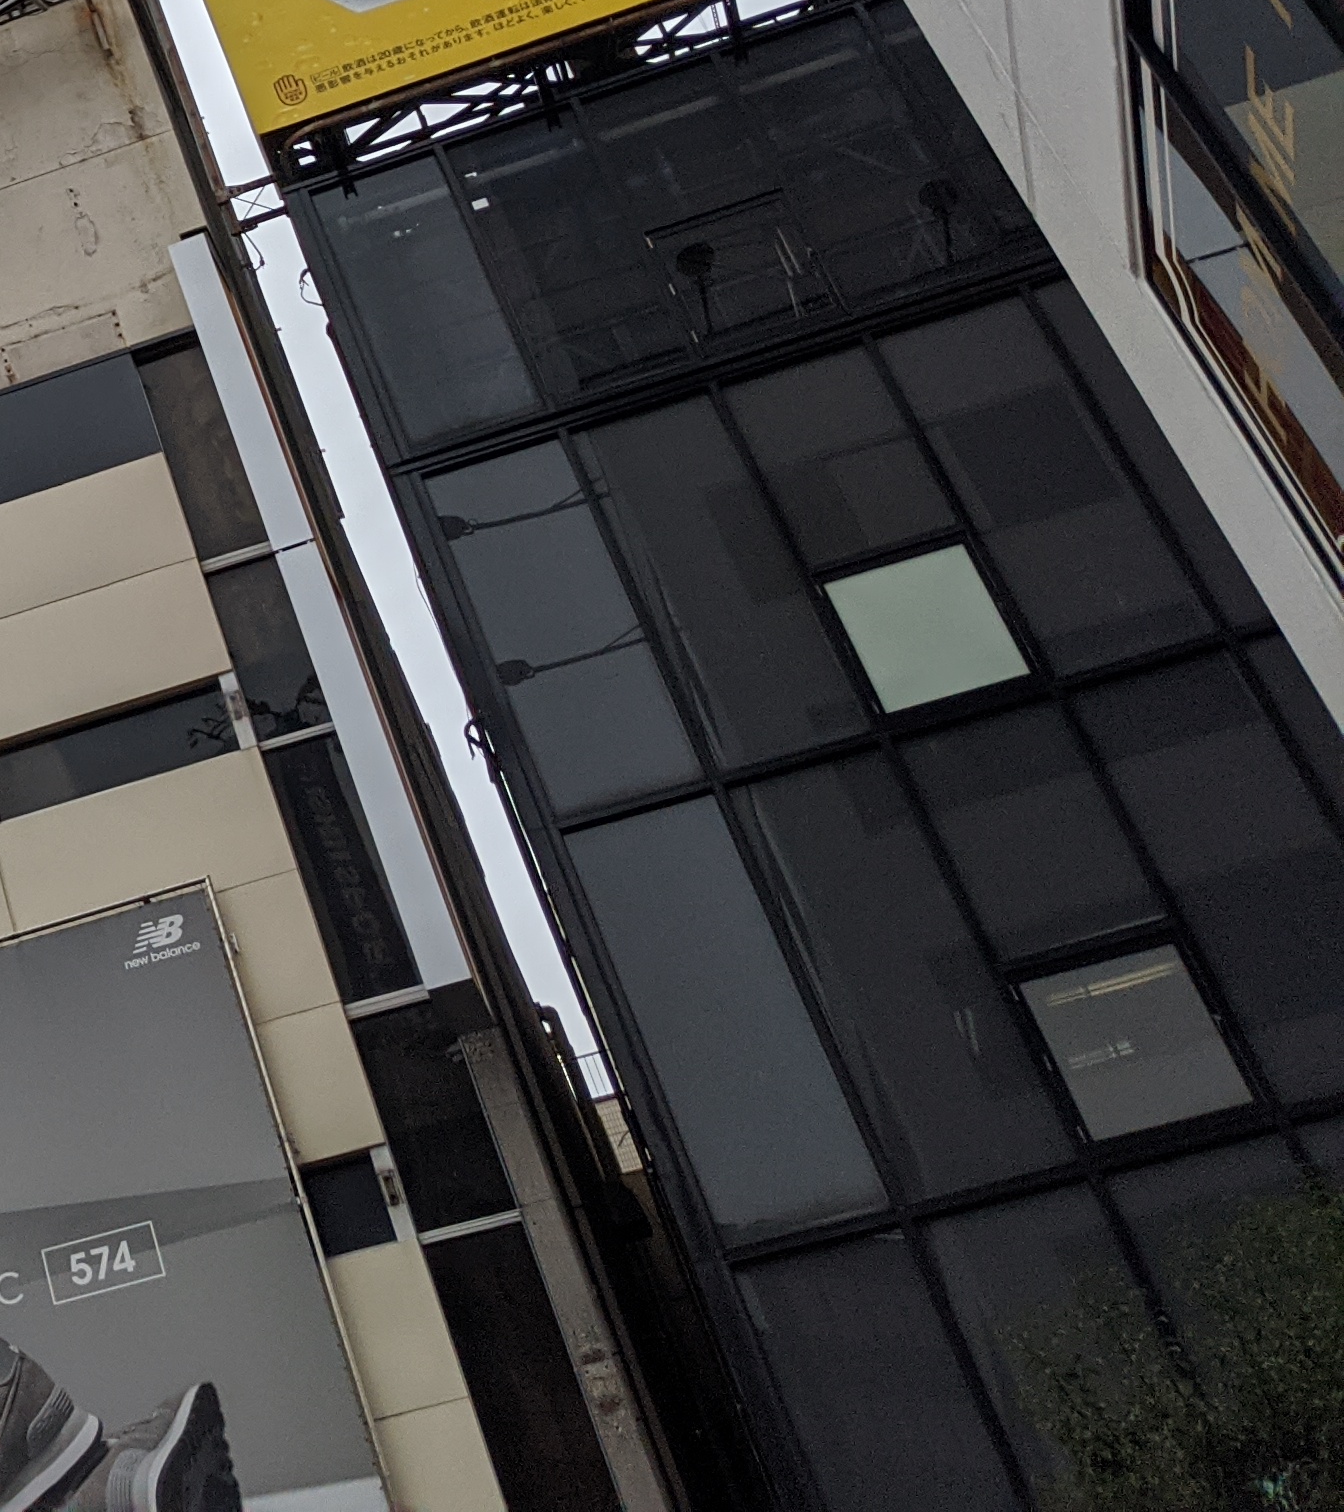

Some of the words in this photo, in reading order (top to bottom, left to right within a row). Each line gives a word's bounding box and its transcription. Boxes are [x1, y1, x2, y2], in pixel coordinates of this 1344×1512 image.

[124, 955, 149, 969] new
[150, 941, 201, 962] balance
[69, 1239, 137, 1286] 574
